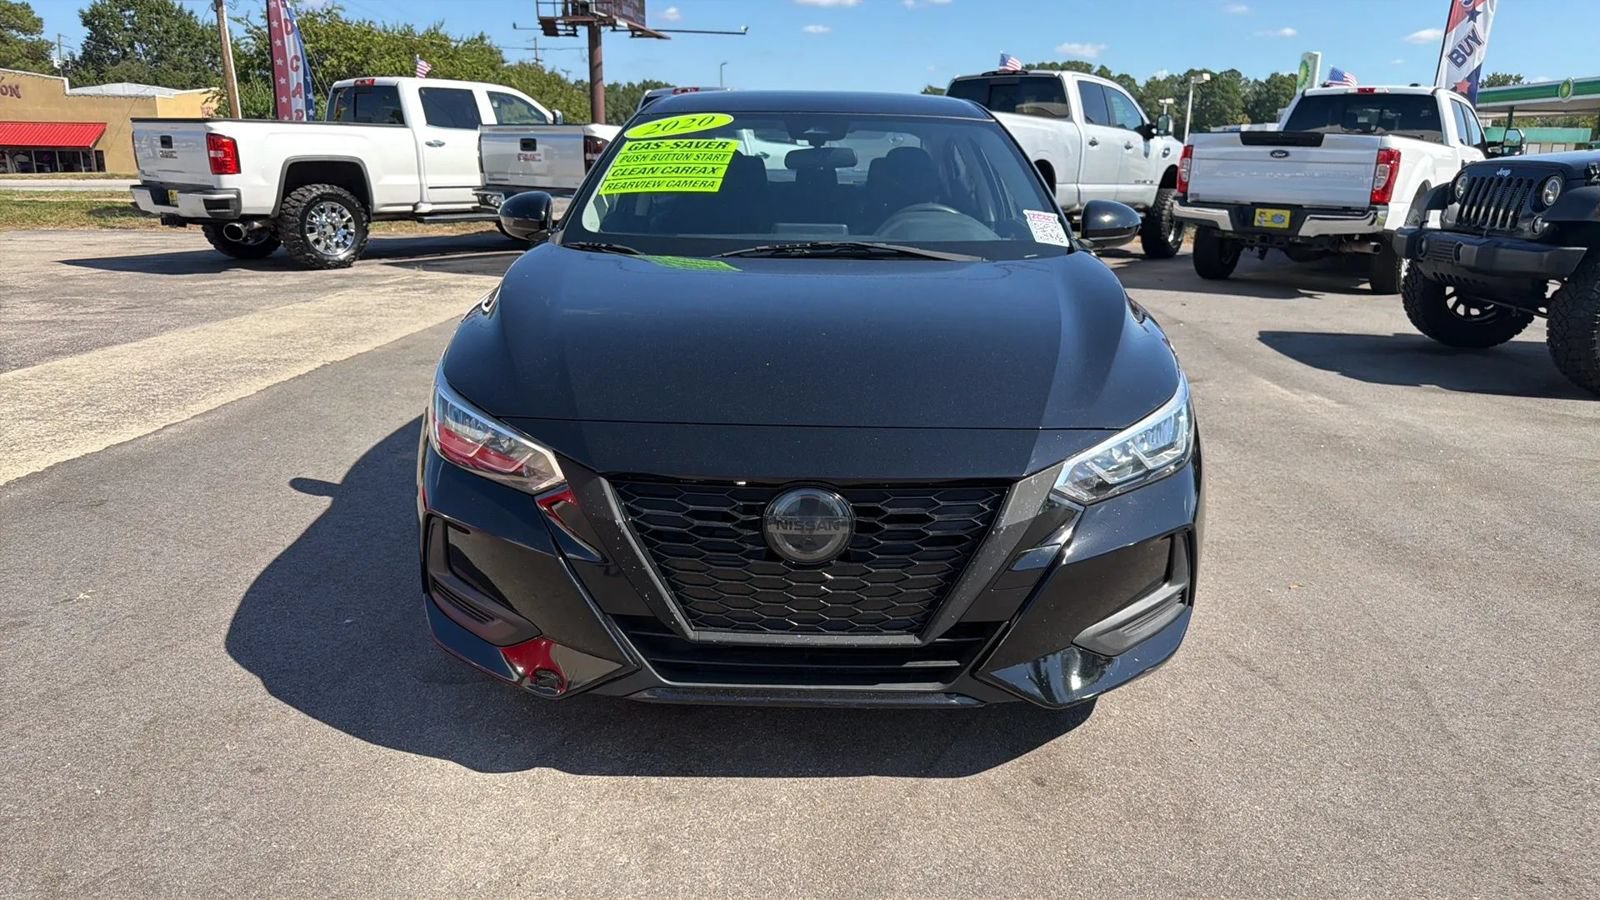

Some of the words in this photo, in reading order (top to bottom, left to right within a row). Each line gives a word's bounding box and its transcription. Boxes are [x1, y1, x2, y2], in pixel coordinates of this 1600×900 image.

[1447, 25, 1483, 69] BUY
[643, 115, 715, 135] 2020
[627, 141, 730, 152] GAS-SAVER
[621, 153, 648, 162] PUSH
[650, 152, 690, 161] BUTTON
[693, 152, 730, 161] START
[611, 166, 659, 177] CLEAN
[660, 165, 720, 175] CARFAX
[605, 179, 664, 190] REARVIEW
[665, 179, 716, 188] CAMERA
[776, 519, 840, 531] NISSAN
